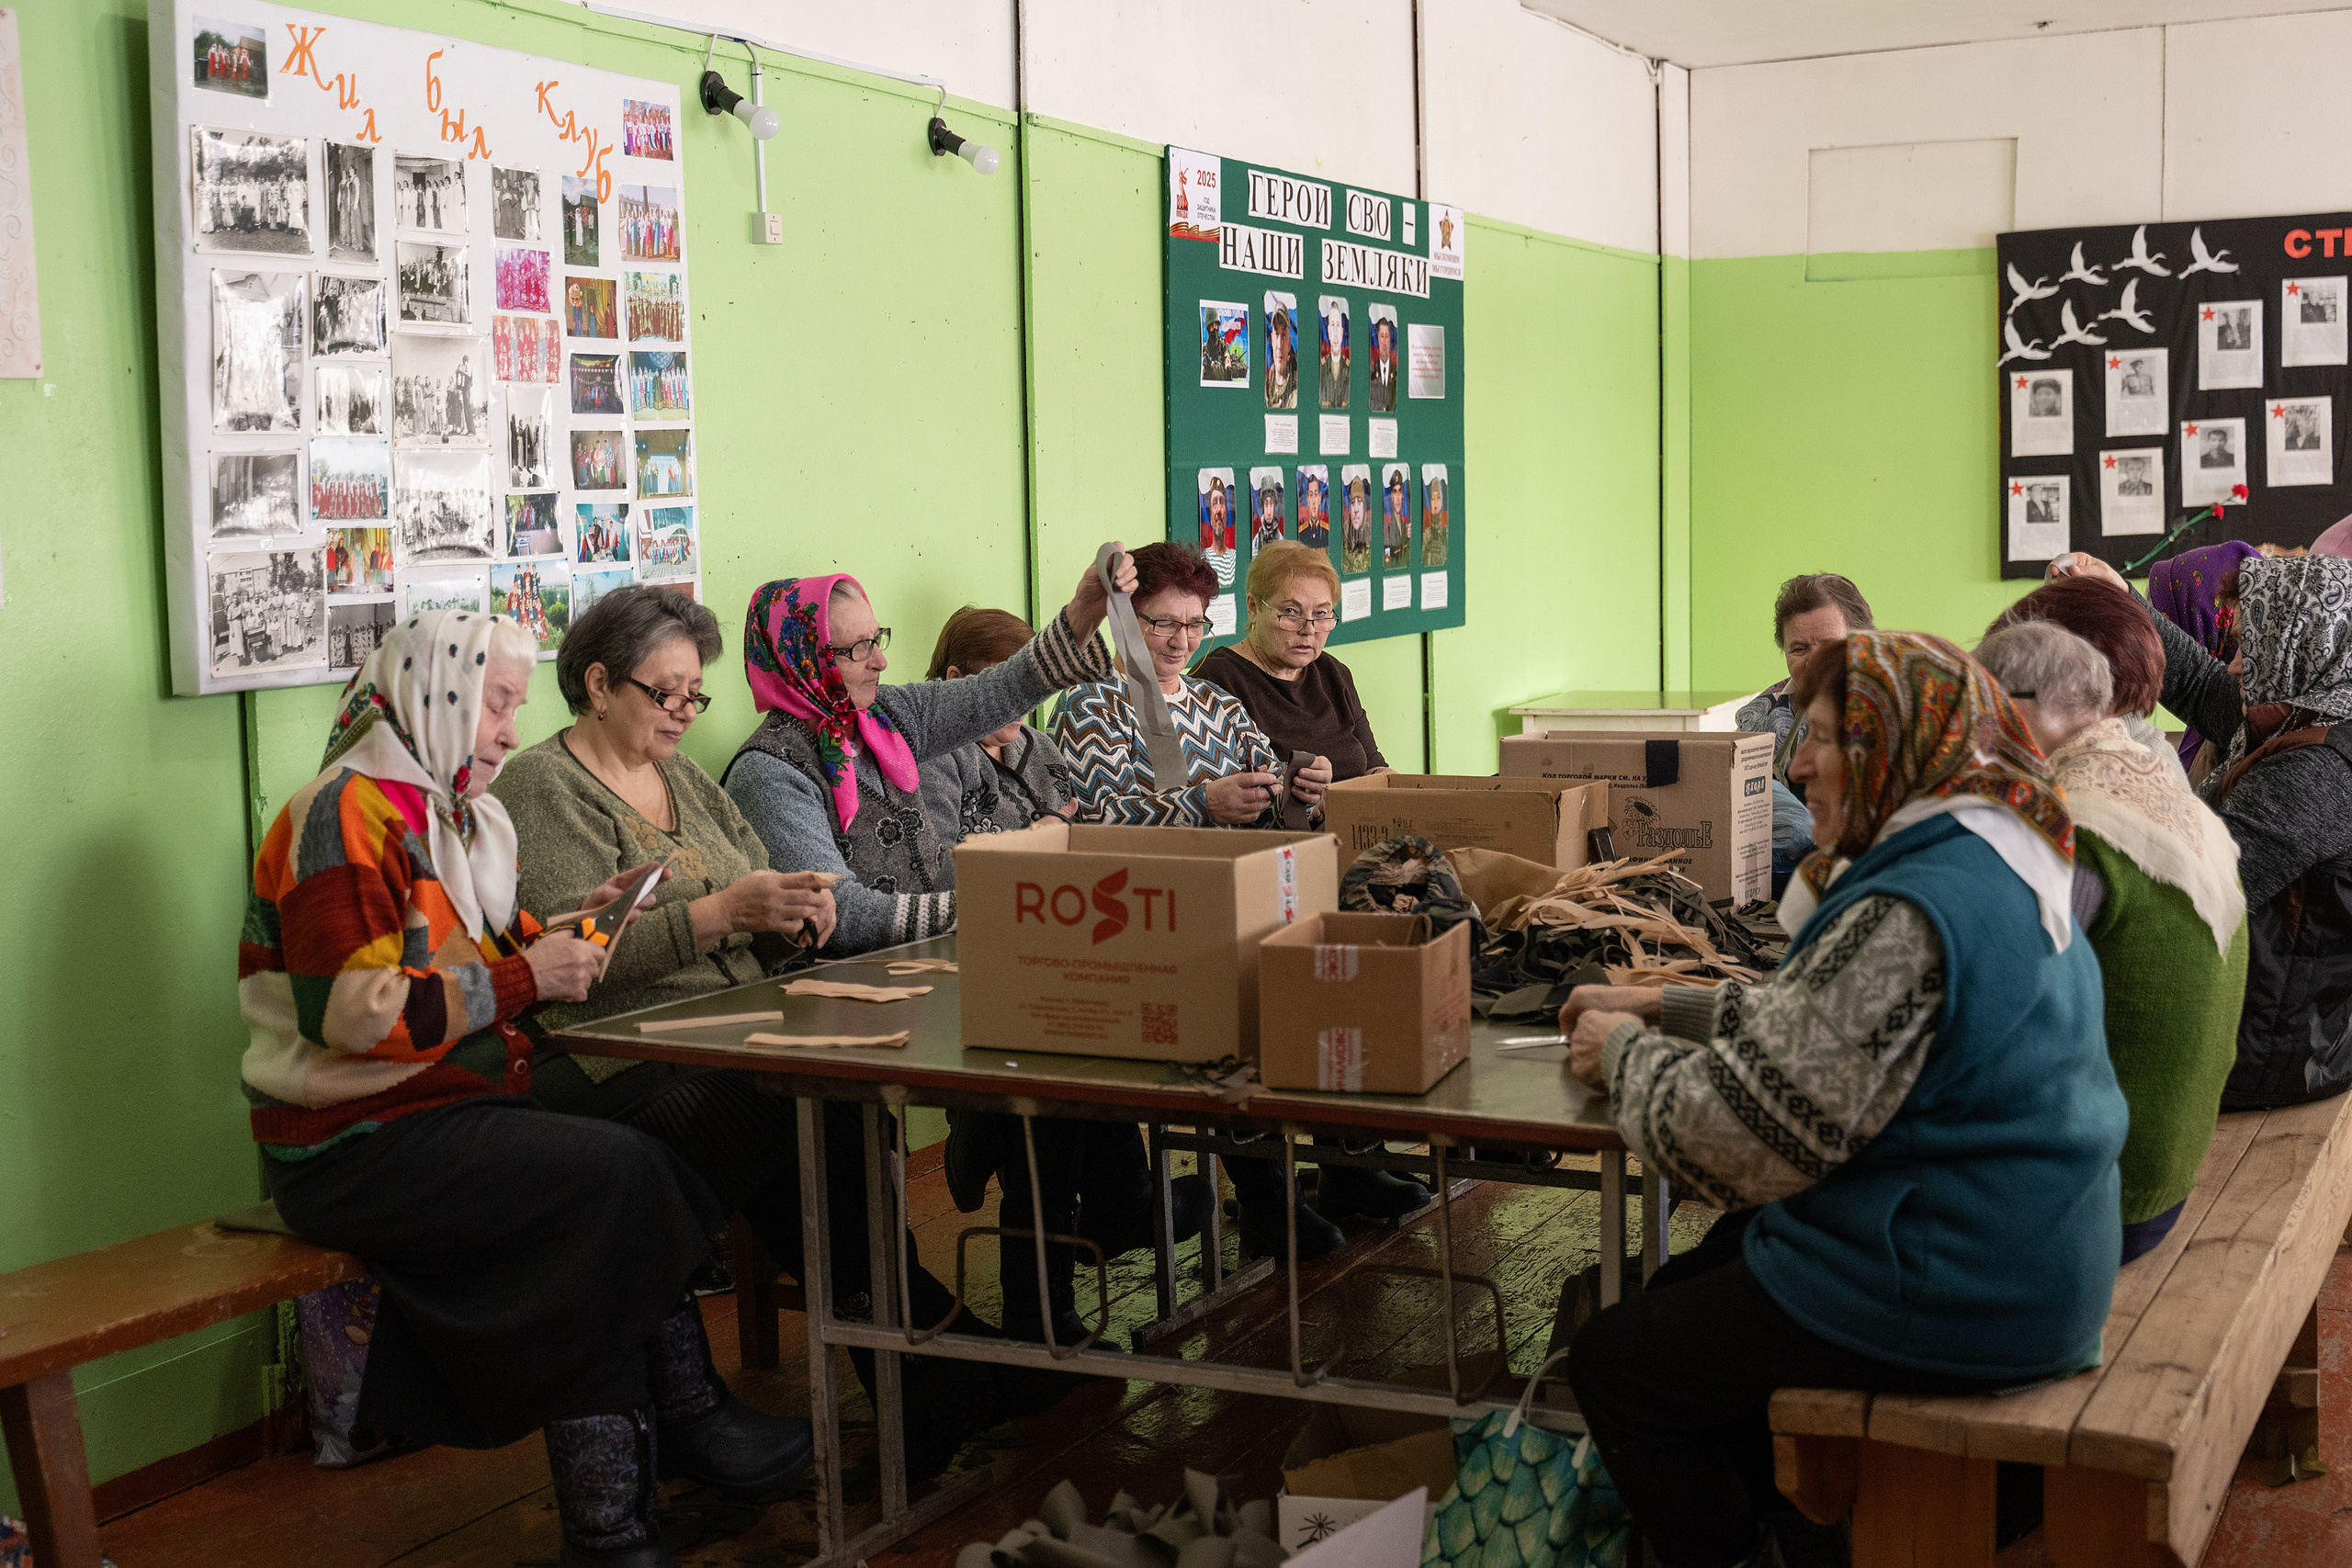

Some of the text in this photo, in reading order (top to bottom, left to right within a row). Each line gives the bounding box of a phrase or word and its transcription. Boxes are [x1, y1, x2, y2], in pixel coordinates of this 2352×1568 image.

[1197, 170, 1216, 188] 2025
[1250, 175, 1330, 225] ГЕРОИ
[1348, 193, 1390, 237] СВО
[1221, 226, 1429, 296] НАШИ ЗЕМЛЯКИ
[1015, 866, 1177, 946] ROSTI
